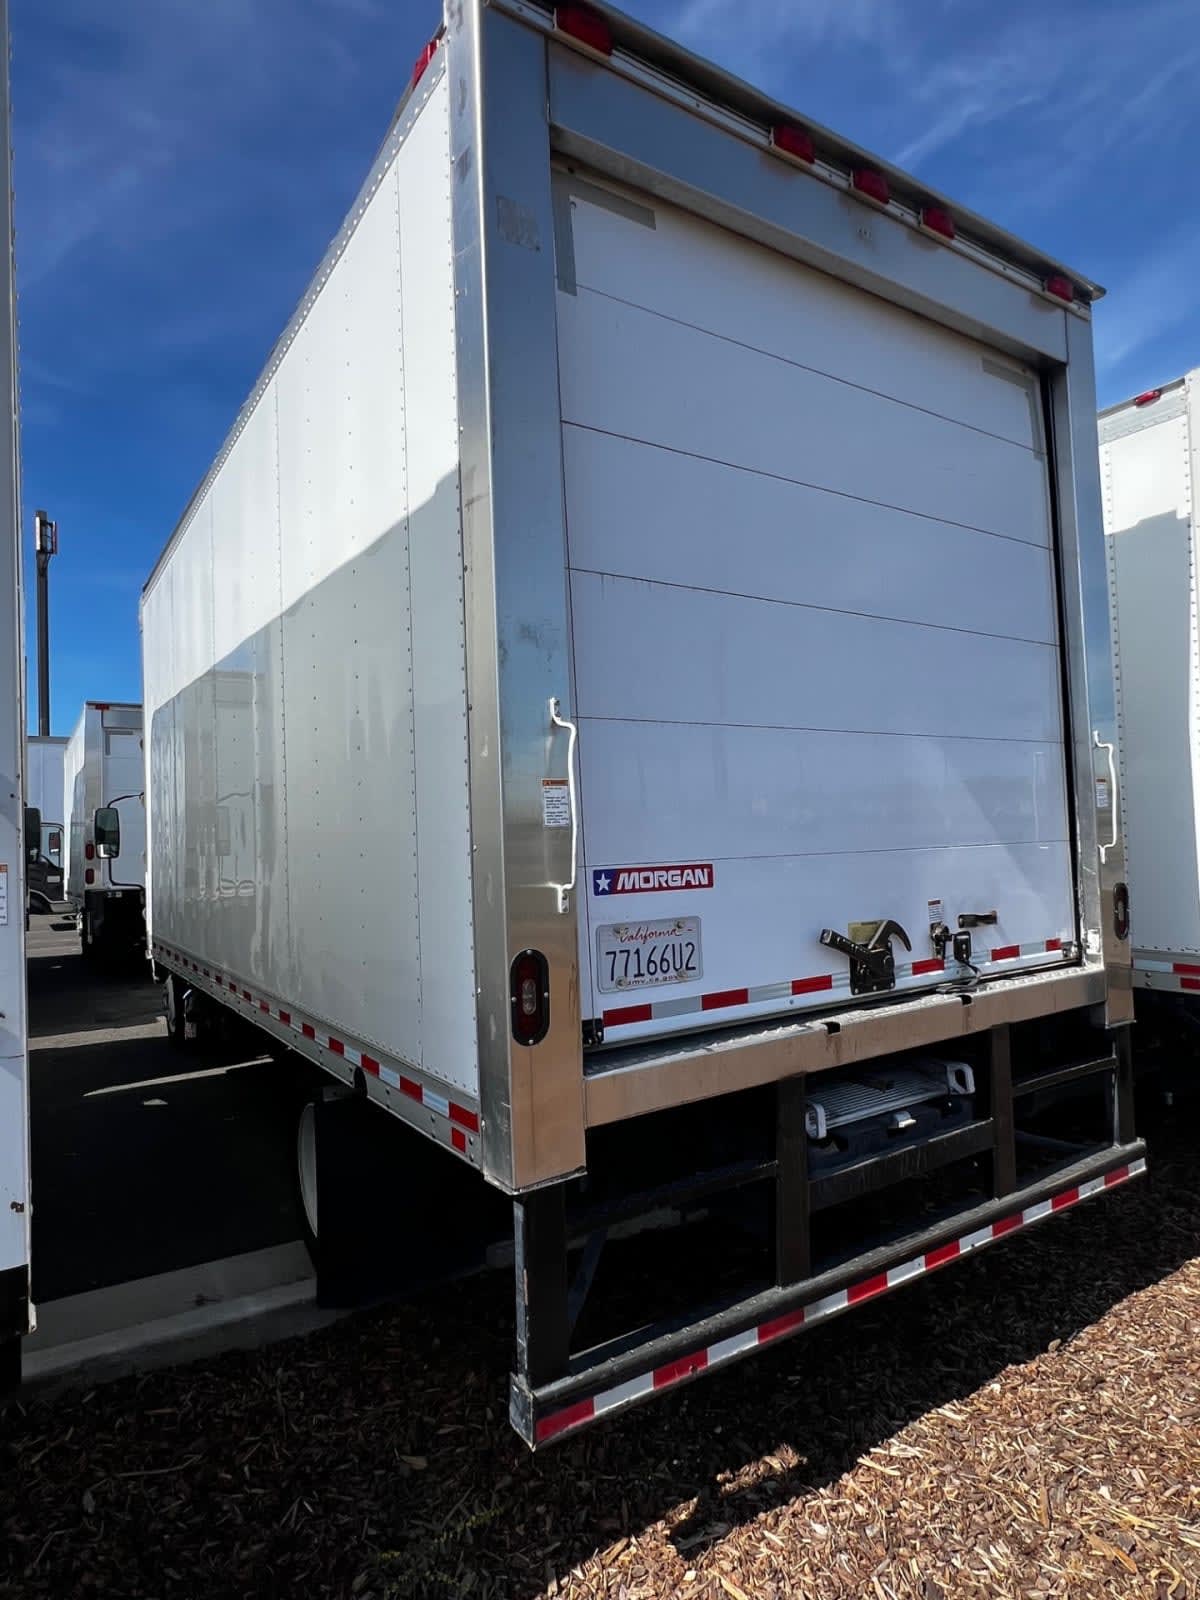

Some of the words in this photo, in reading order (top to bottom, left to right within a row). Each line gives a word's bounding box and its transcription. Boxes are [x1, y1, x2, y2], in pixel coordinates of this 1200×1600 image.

[617, 869, 708, 890] MORGAN
[621, 925, 682, 944] California
[605, 942, 696, 981] 77166U2
